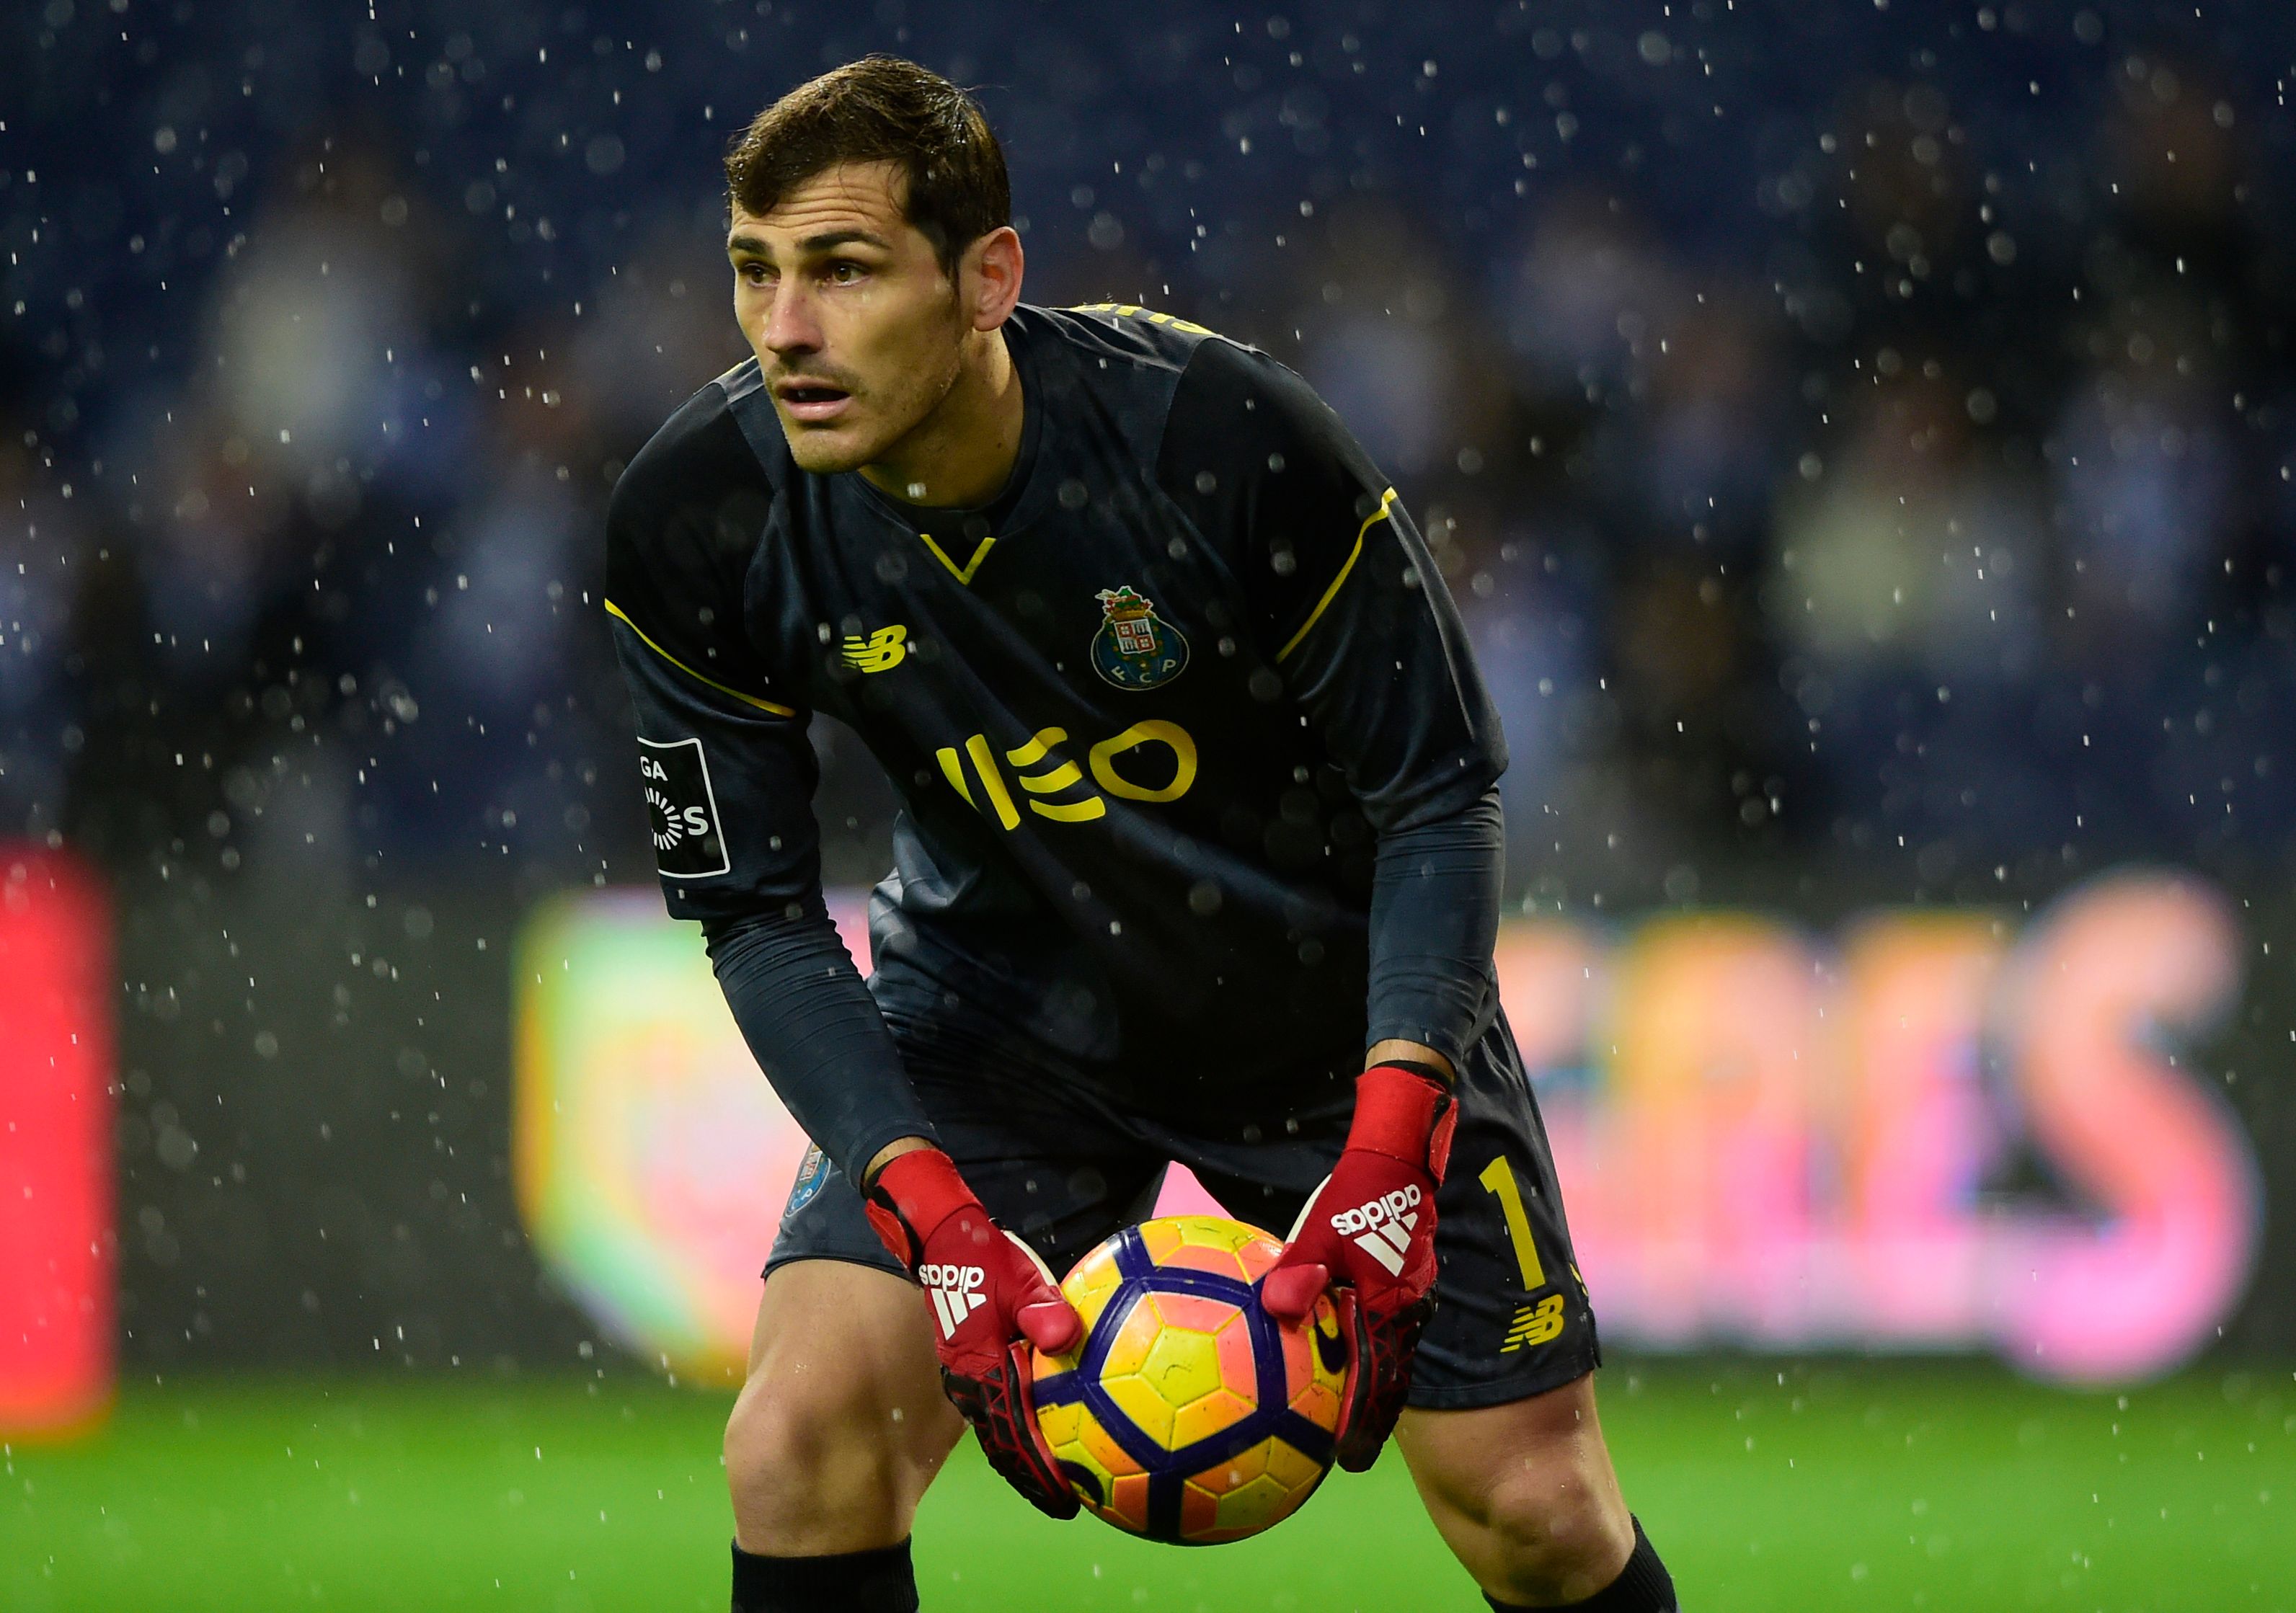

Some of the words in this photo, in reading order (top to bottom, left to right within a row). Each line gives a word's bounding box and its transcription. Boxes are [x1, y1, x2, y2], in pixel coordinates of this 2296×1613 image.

[639, 756, 668, 781] GA
[1331, 1183, 1422, 1236] adidas
[1479, 1155, 1546, 1292] 1
